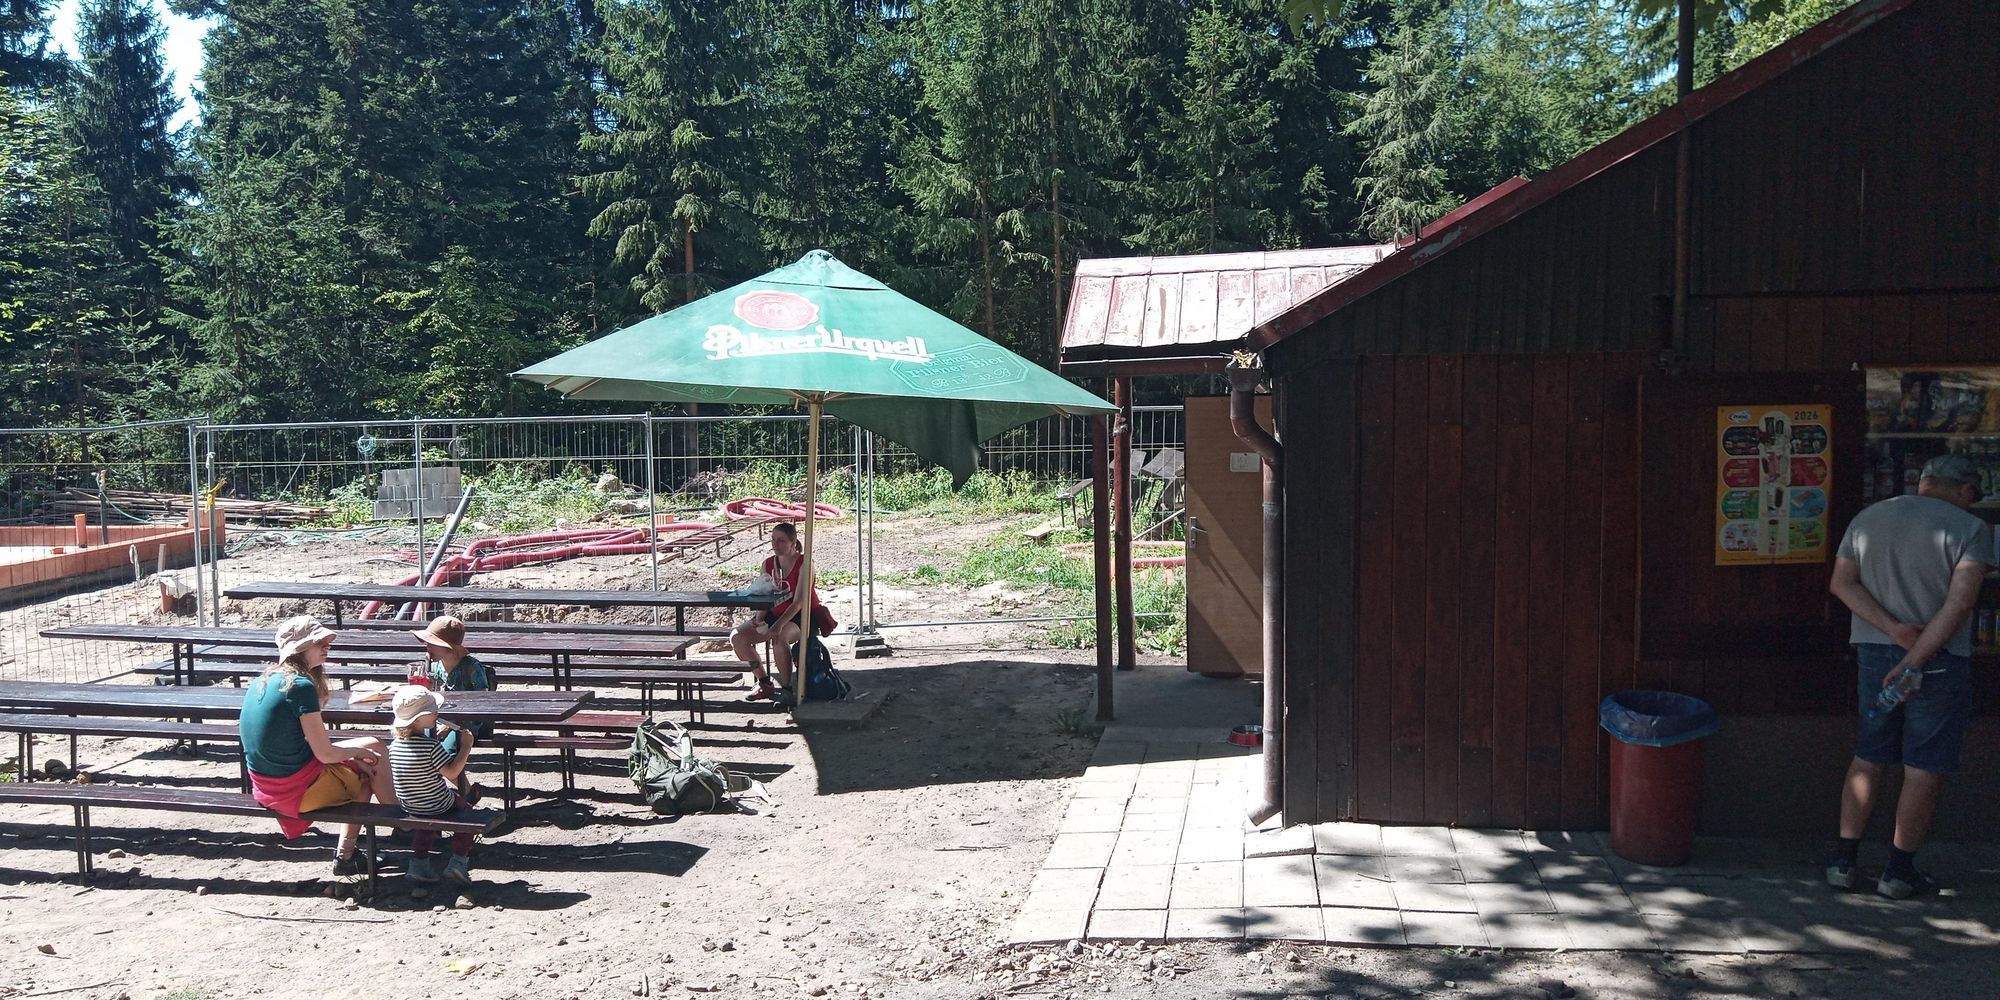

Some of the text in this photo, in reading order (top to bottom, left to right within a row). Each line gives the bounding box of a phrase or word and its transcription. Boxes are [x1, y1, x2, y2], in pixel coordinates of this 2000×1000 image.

[703, 324, 928, 360] Pilsner Urquell
[905, 355, 1005, 378] Pilsner Bier
[1794, 411, 1818, 420] 2026
